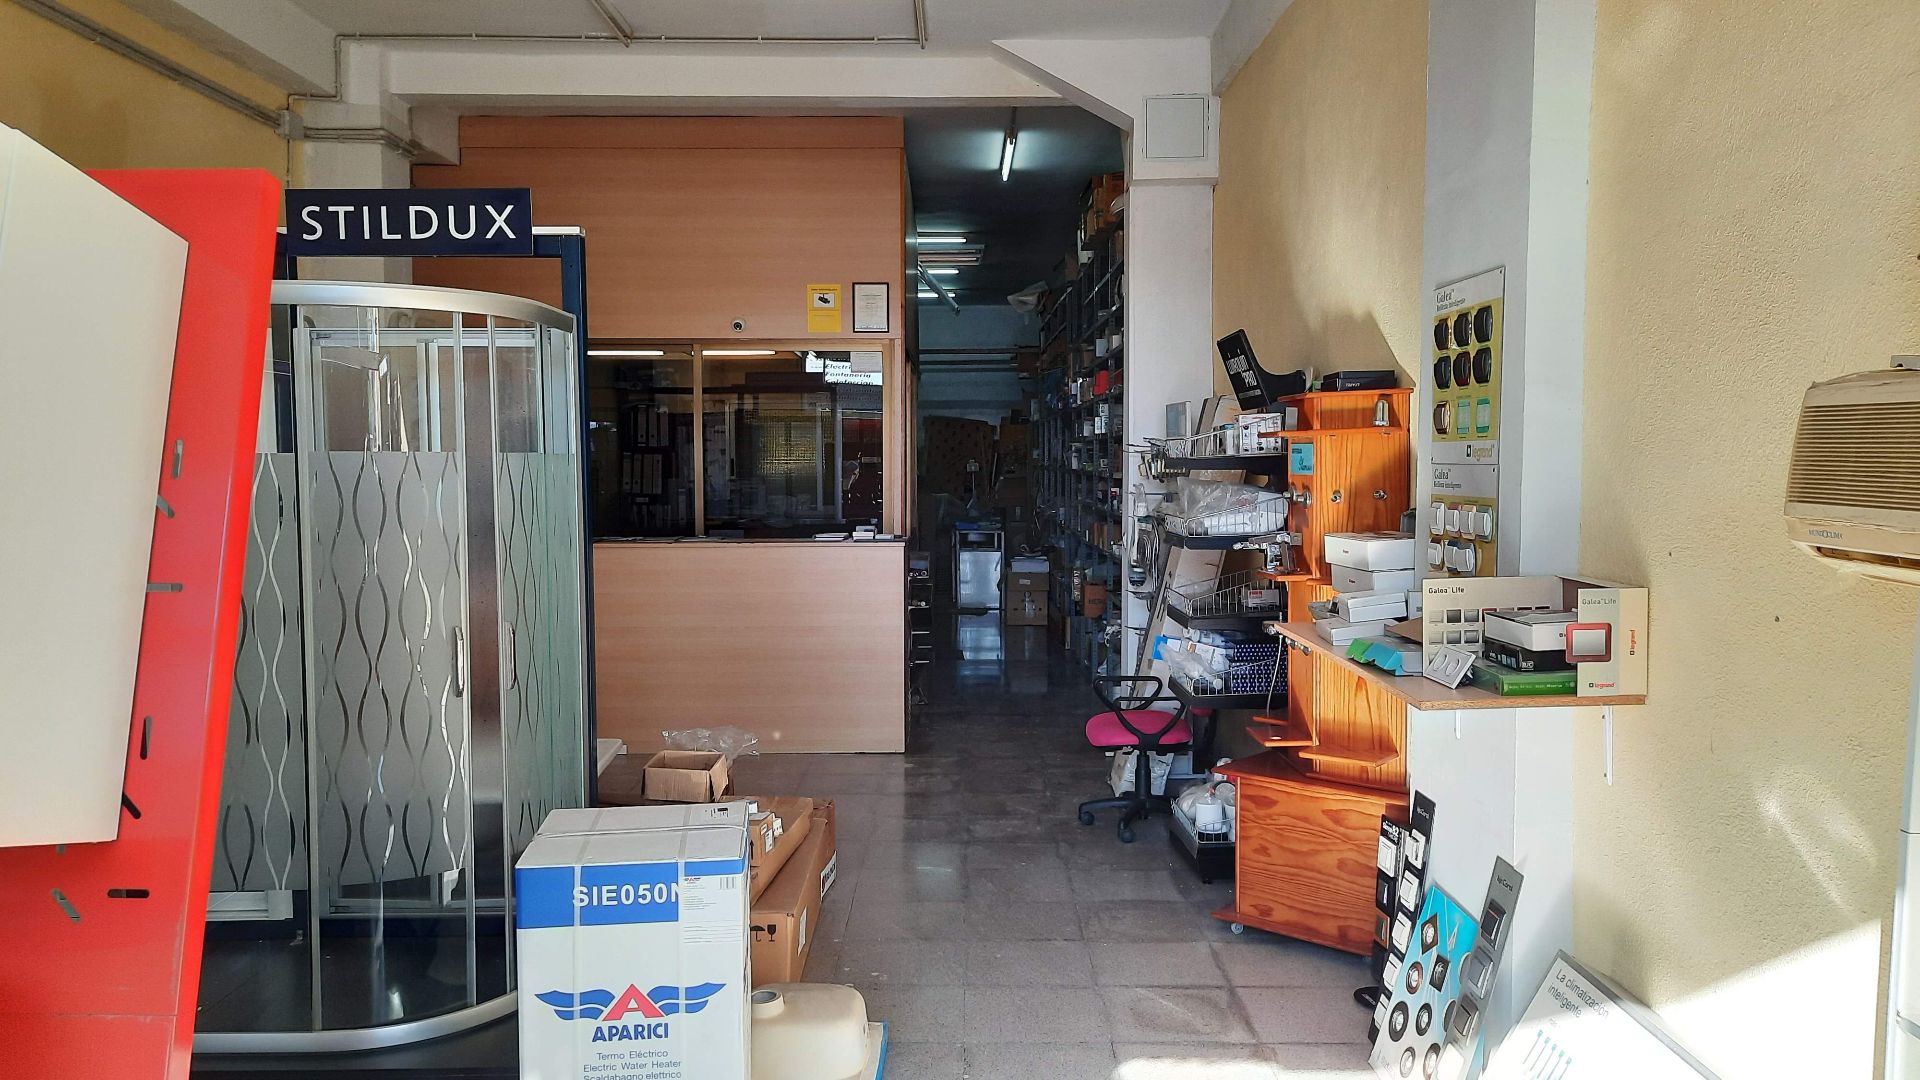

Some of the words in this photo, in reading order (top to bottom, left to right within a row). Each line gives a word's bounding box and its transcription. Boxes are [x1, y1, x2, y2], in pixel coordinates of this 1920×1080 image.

[301, 204, 517, 241] STILDUX
[1451, 586, 1465, 594] Life
[1547, 982, 1582, 1018] inteligente
[1555, 968, 1567, 983] La
[1565, 979, 1609, 1018] climatización
[592, 1023, 669, 1042] APARICI
[596, 1053, 625, 1061] Termo
[629, 1050, 669, 1059] Eléctrico
[583, 1064, 617, 1072] Electric
[621, 1062, 648, 1070] Water
[651, 1060, 681, 1069] Heater
[645, 1071, 681, 1080] elettrico
